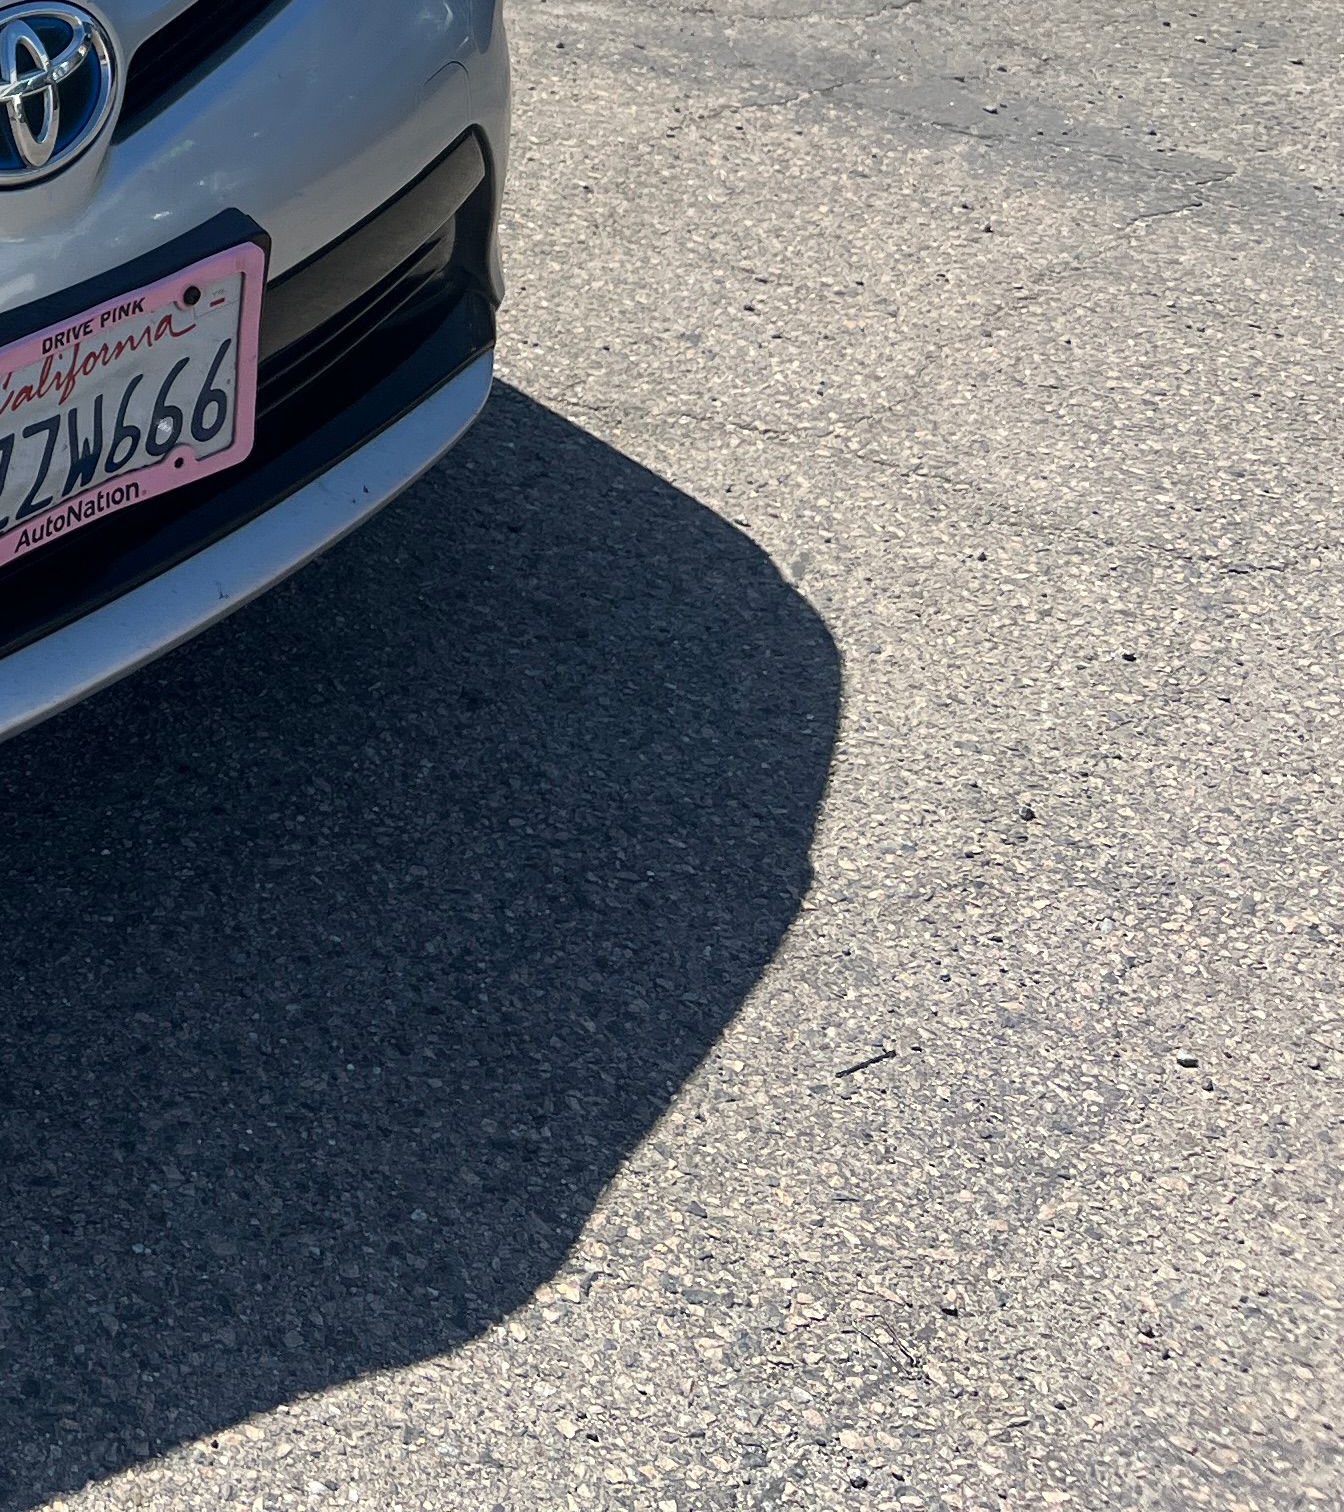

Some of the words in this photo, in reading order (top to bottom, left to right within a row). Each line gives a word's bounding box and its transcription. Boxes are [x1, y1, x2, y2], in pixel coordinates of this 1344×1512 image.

[42, 319, 93, 354] DRIVE
[100, 297, 145, 329] PINK
[15, 481, 139, 553] AutoNation
